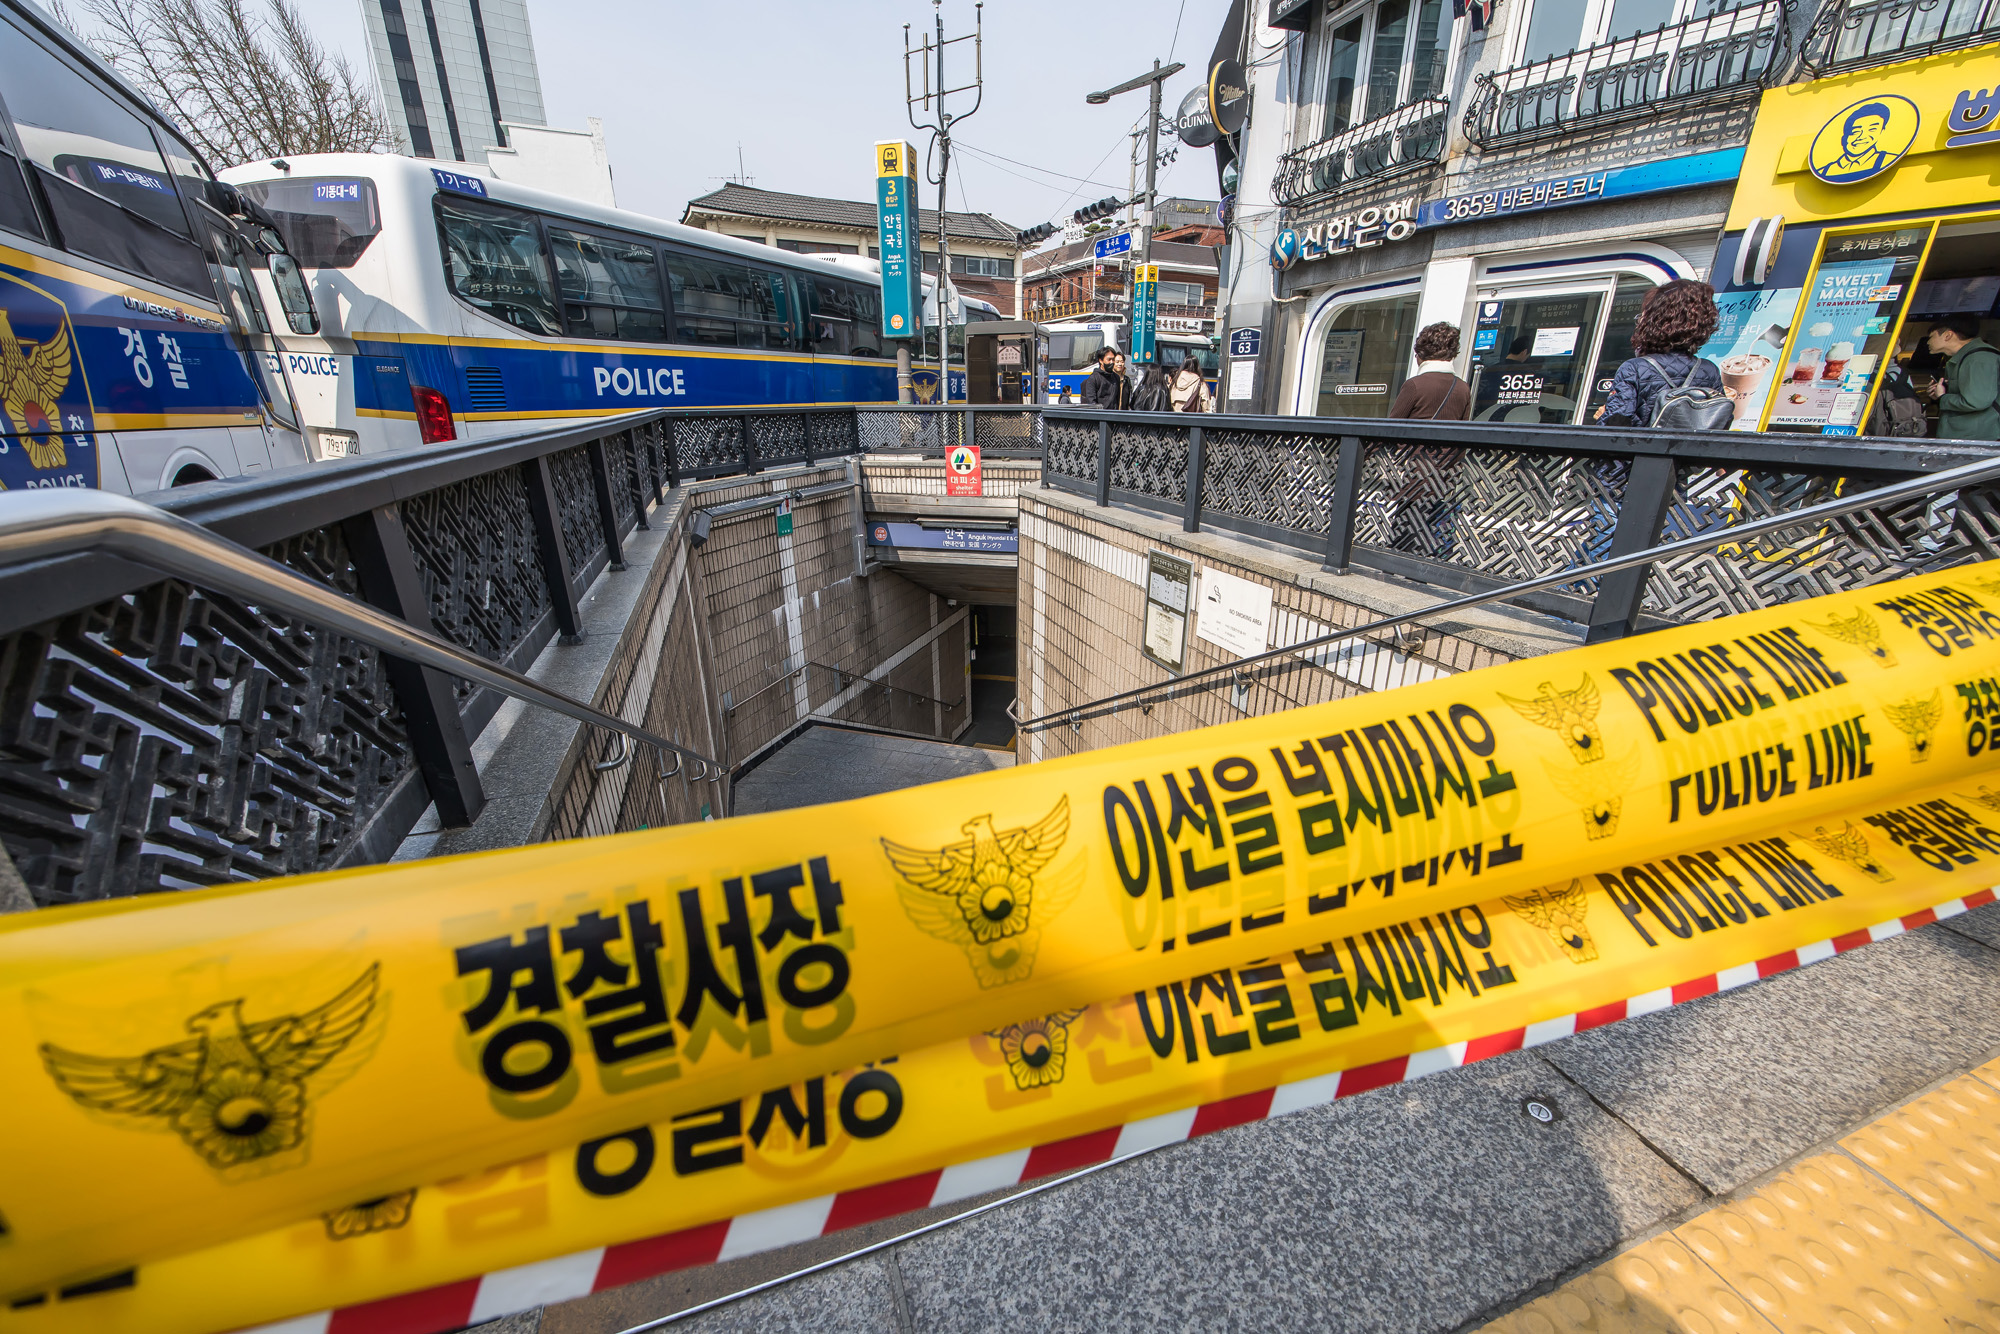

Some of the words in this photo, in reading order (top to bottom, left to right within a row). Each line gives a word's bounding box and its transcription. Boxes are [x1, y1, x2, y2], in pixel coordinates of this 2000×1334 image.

[1219, 84, 1246, 102] Miller
[316, 184, 359, 199] 1기동대-예
[887, 180, 896, 195] 3
[1443, 192, 1499, 221] 365일
[1501, 172, 1608, 210] 바로바로코너
[884, 214, 896, 248] 안국
[1302, 196, 1417, 261] 신한은행
[1840, 235, 1912, 252] 휴게음식점
[1824, 273, 1883, 288] SWEET
[1238, 341, 1251, 354] 63
[117, 326, 190, 390] 경찰
[289, 355, 340, 377] POLICE
[593, 367, 686, 396] POLICE
[1499, 374, 1544, 391] 365일
[1498, 390, 1541, 400] 바로바로코너
[1825, 428, 1854, 436] CESCO
[950, 476, 978, 485] 대피소
[944, 528, 966, 540] 안국
[967, 533, 987, 542] Anguk
[1235, 610, 1252, 622] SMOKING
[1608, 643, 1776, 743] POLICE
[1732, 626, 1848, 701] LINE
[1803, 714, 1875, 791] LINE
[1103, 756, 1285, 900] 이선을
[1269, 702, 1518, 856] 넘지마시오
[1595, 851, 1772, 947] POLICE
[1729, 836, 1846, 911] LINE
[454, 855, 850, 1093] 경찰서장
